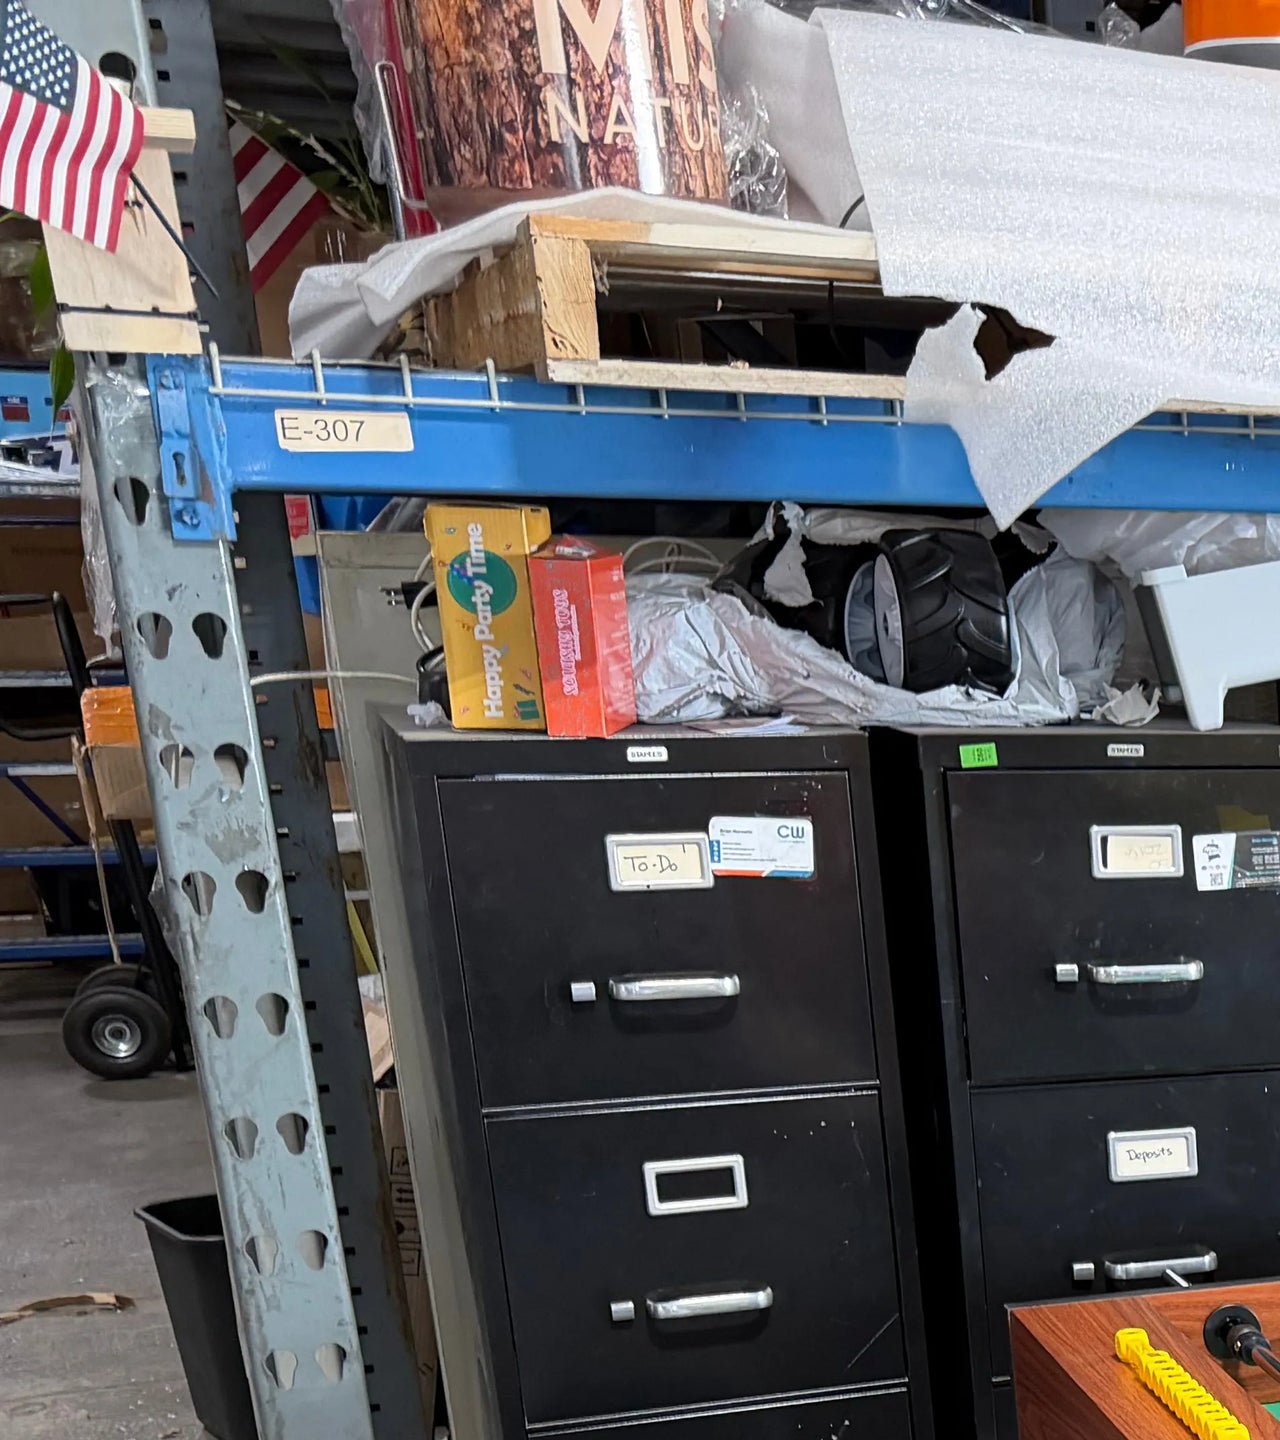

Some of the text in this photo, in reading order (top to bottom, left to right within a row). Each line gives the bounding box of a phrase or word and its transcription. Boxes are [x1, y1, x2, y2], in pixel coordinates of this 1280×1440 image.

[280, 416, 365, 442] E-307
[467, 522, 504, 718] Happy Party Time
[777, 825, 805, 839] CW
[1126, 1146, 1173, 1164] Deposits
